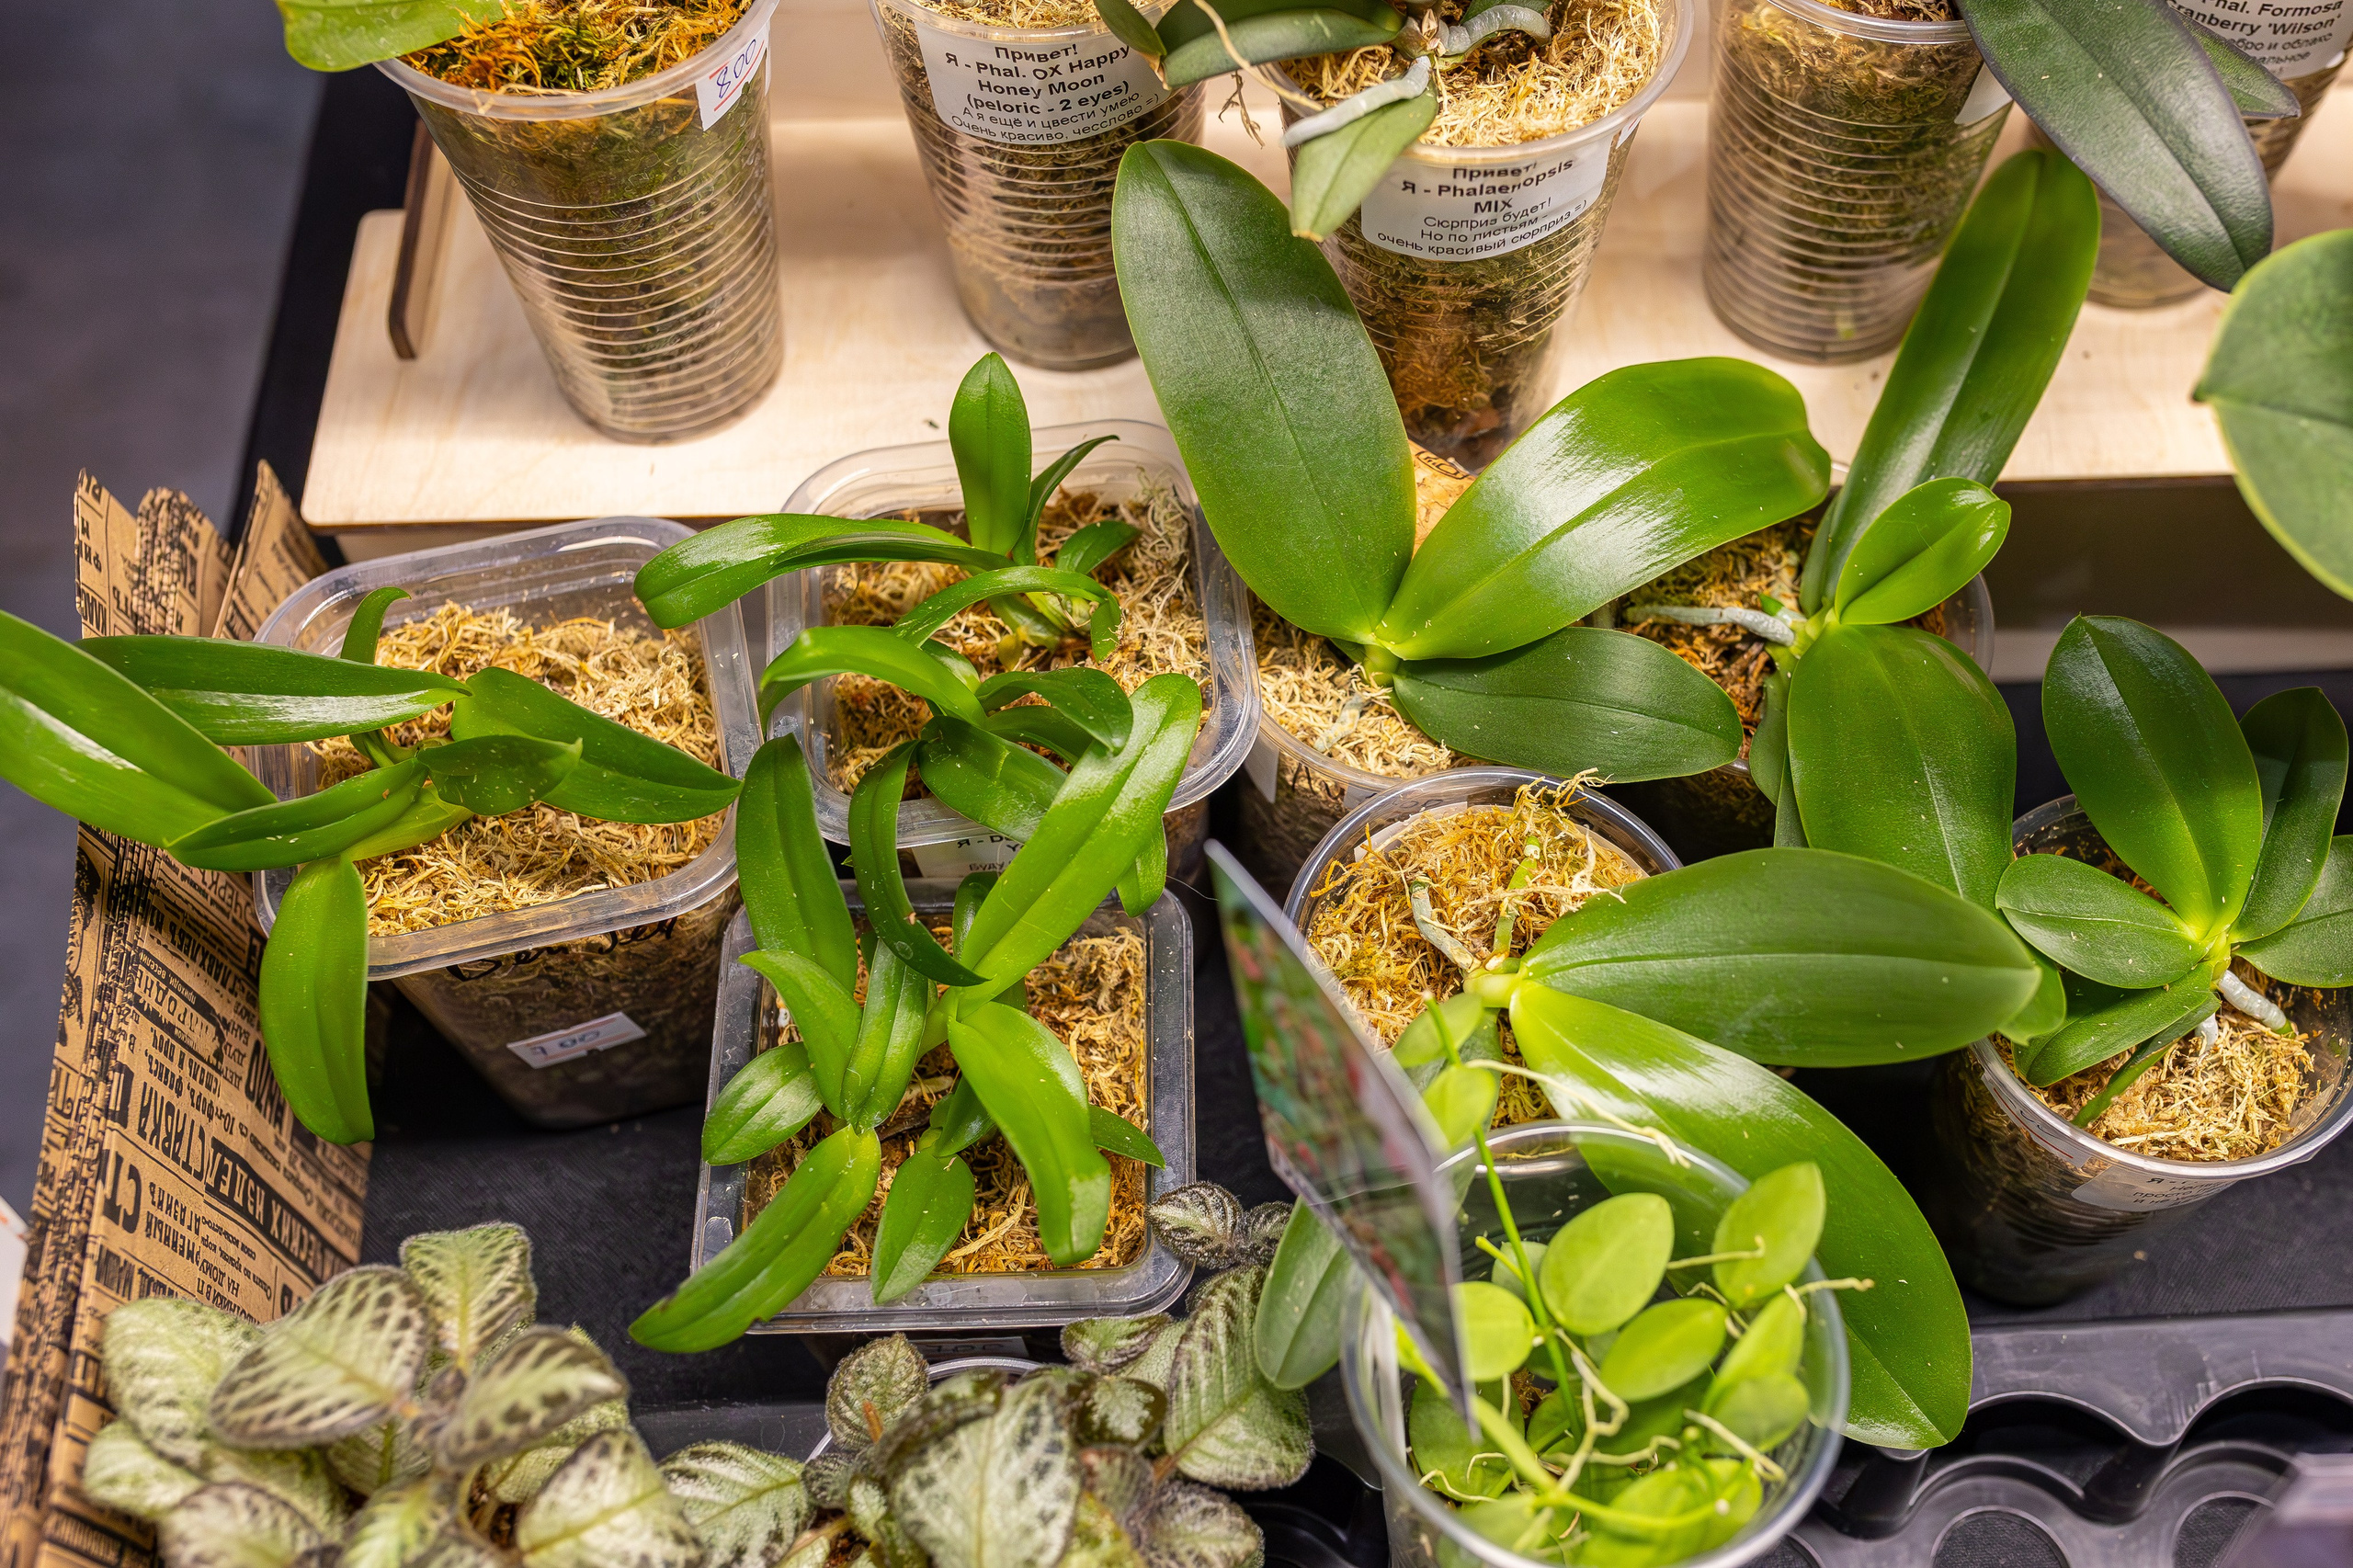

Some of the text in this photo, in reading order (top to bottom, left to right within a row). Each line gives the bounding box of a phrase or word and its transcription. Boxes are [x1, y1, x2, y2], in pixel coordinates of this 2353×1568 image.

[2258, 0, 2344, 17] Formosa
[946, 52, 959, 67] Я
[976, 62, 1026, 78] Phal.
[1033, 64, 1063, 80] OX
[1069, 45, 1130, 74] Happy
[995, 44, 1077, 62] Привет!
[967, 94, 1040, 115] (peloric
[1059, 98, 1072, 111] 2
[1078, 80, 1129, 107] eyes)
[978, 74, 1105, 99] Honey Moon
[951, 116, 996, 137] Очень
[1073, 105, 1142, 135] чесслово
[963, 107, 973, 119] А
[976, 112, 984, 121] я
[990, 116, 1022, 129] ещё
[1027, 119, 1036, 129] и
[1041, 110, 1096, 130] цвести
[1402, 180, 1415, 194] Я
[1438, 160, 1574, 197] Phalaenopsis
[1453, 163, 1537, 182] Привет!
[1424, 197, 1552, 232] Сюрприз будет!
[1473, 198, 1512, 214] MIX
[1378, 233, 1423, 251] очень
[1428, 238, 1506, 256] красивый
[1511, 211, 1571, 244] сюрприз
[1421, 229, 1443, 241] Но
[1449, 233, 1468, 243] по
[1472, 217, 1538, 243] листьям
[958, 838, 971, 848] Я
